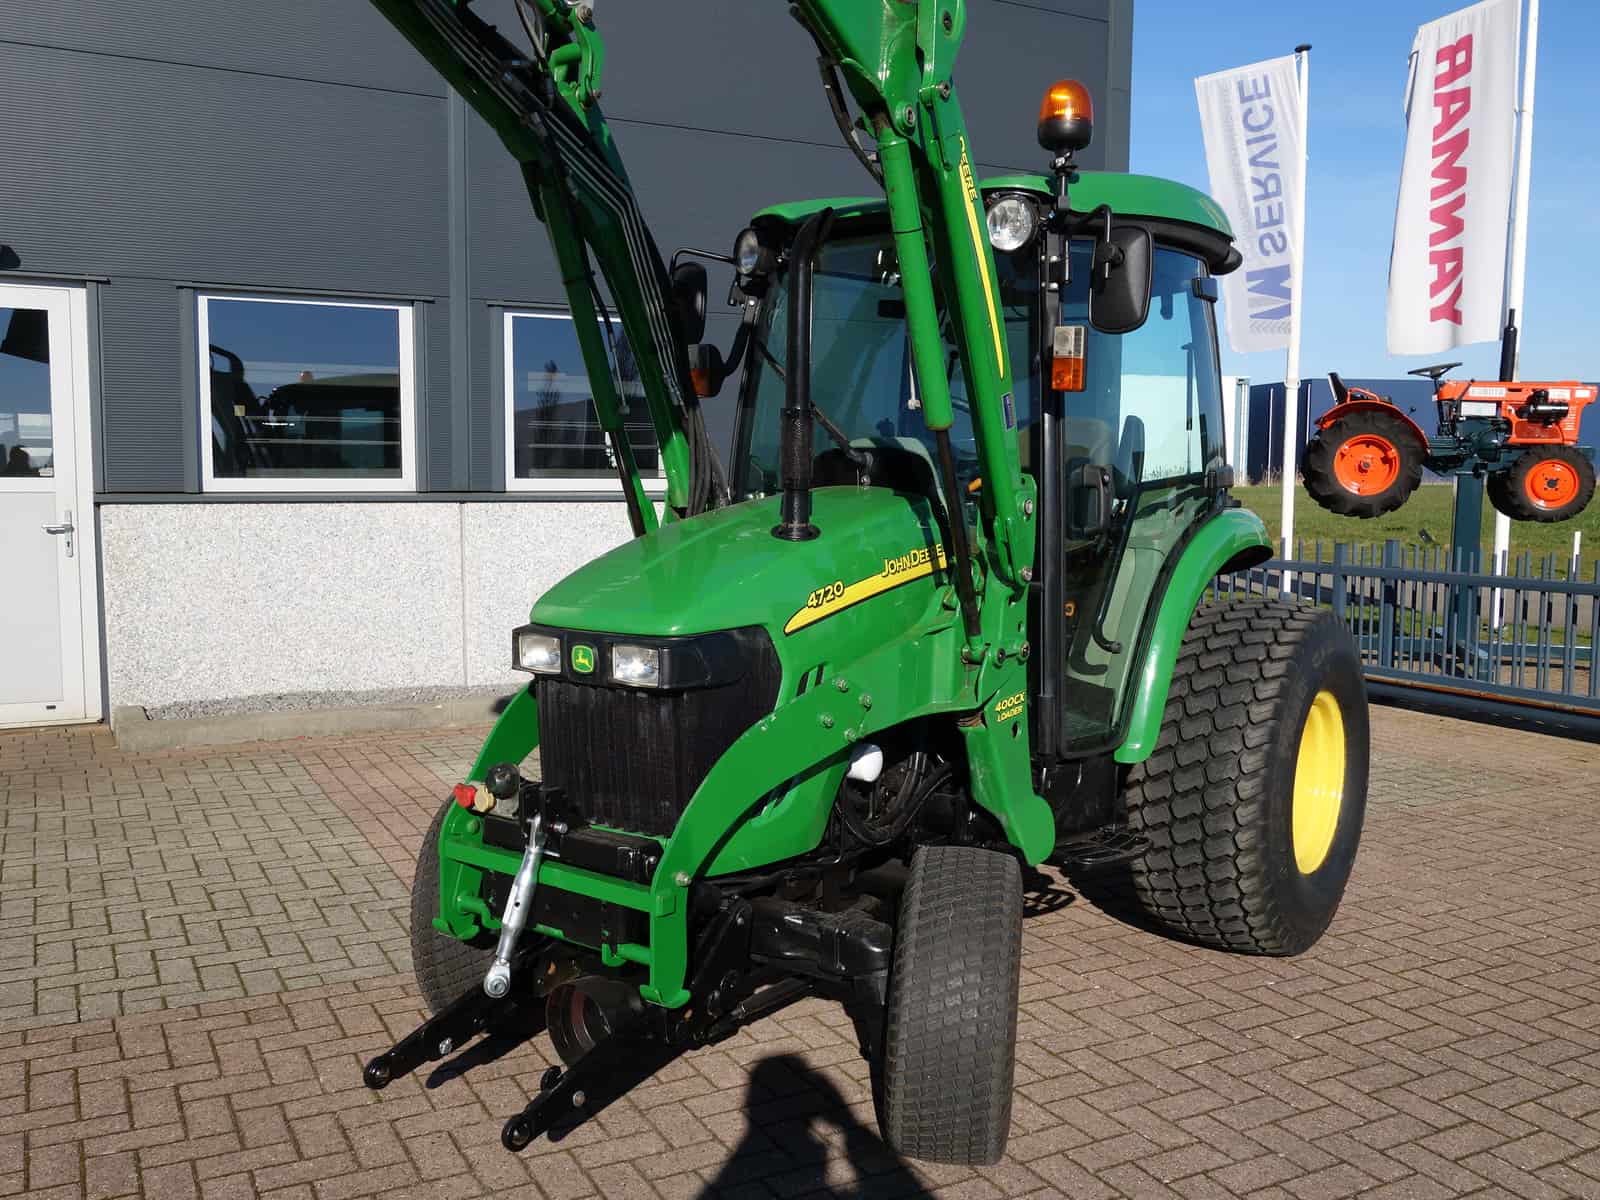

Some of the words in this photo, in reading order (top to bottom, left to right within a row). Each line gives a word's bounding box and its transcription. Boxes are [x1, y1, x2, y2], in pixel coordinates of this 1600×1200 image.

[881, 555, 912, 577] JOHN
[806, 580, 844, 608] 4720
[997, 704, 1023, 722] LOADER
